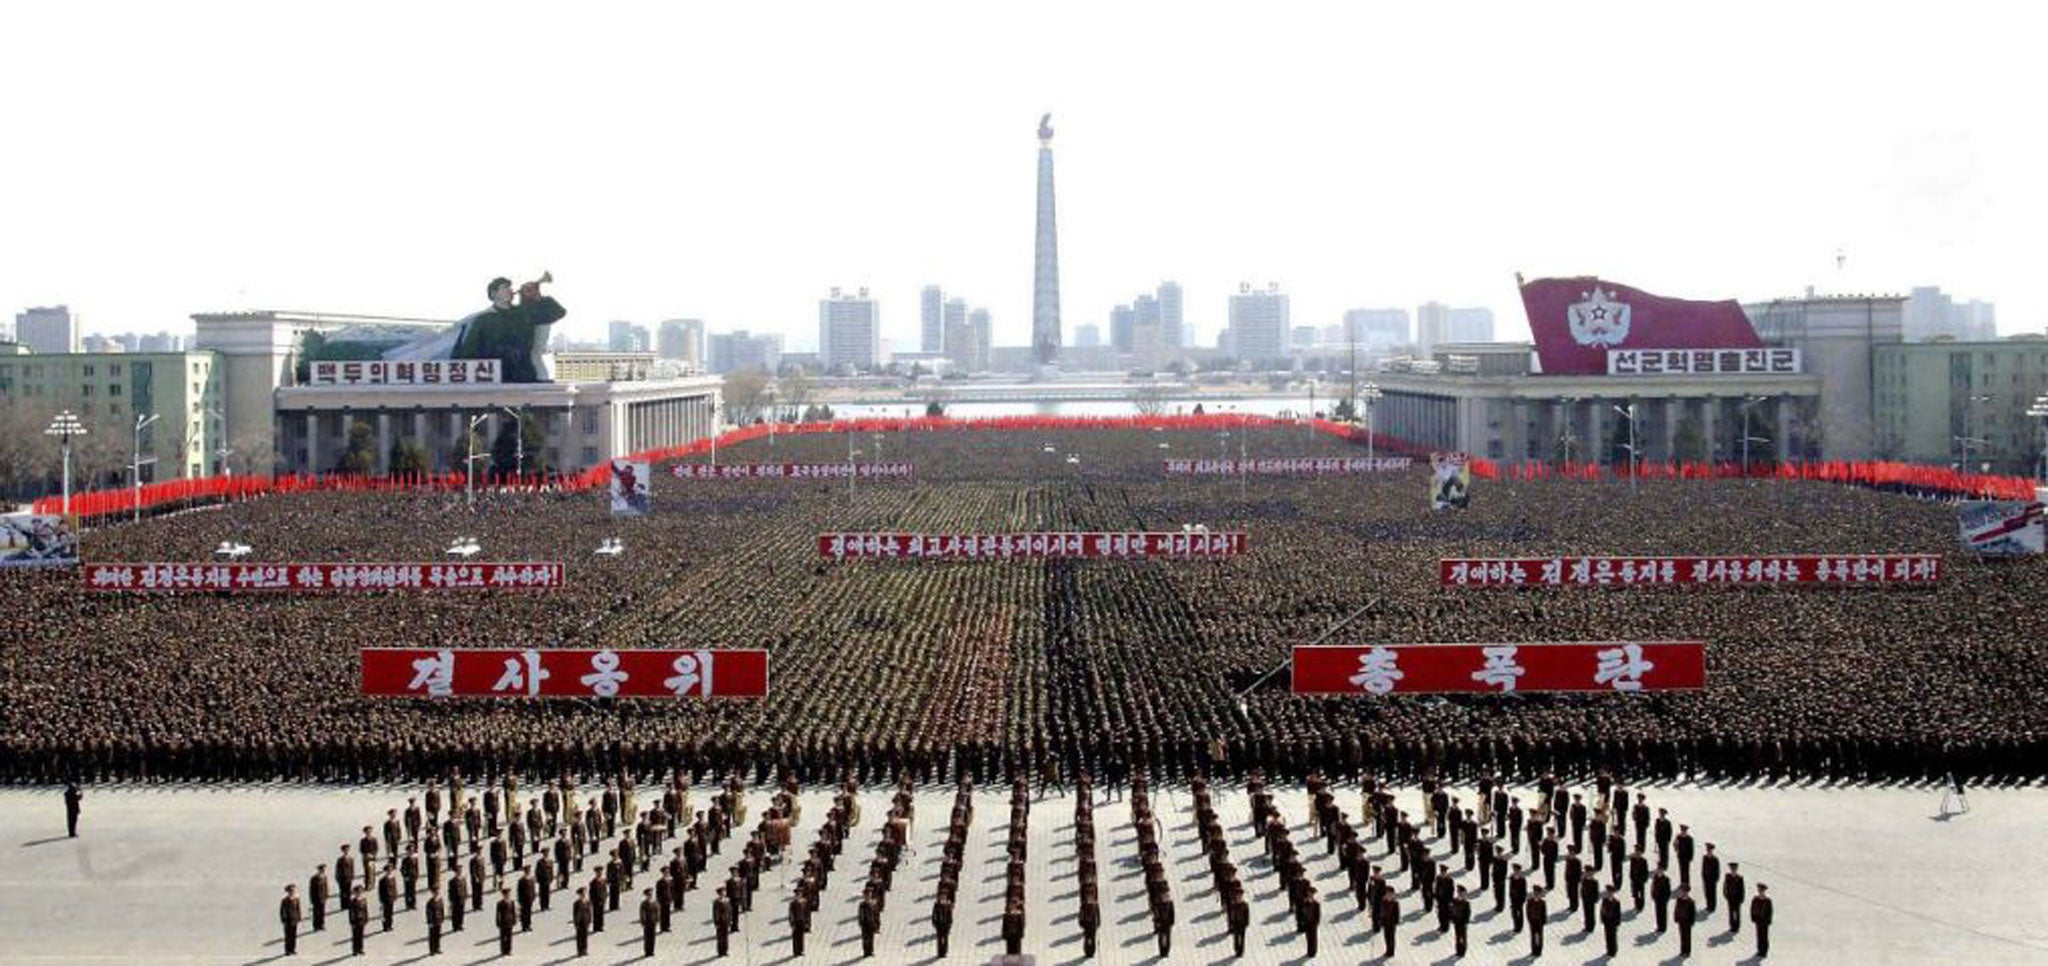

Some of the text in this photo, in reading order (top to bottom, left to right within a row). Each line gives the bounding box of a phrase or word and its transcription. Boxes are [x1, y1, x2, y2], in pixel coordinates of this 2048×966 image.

[828, 534, 899, 556] 경애하는
[1095, 533, 1148, 556] 명령만
[140, 564, 231, 588] 김정은동지를
[1450, 562, 1526, 583] 경애하는
[1540, 558, 1676, 583] 김정은동지를
[1691, 559, 1800, 583] 결사옹위하는
